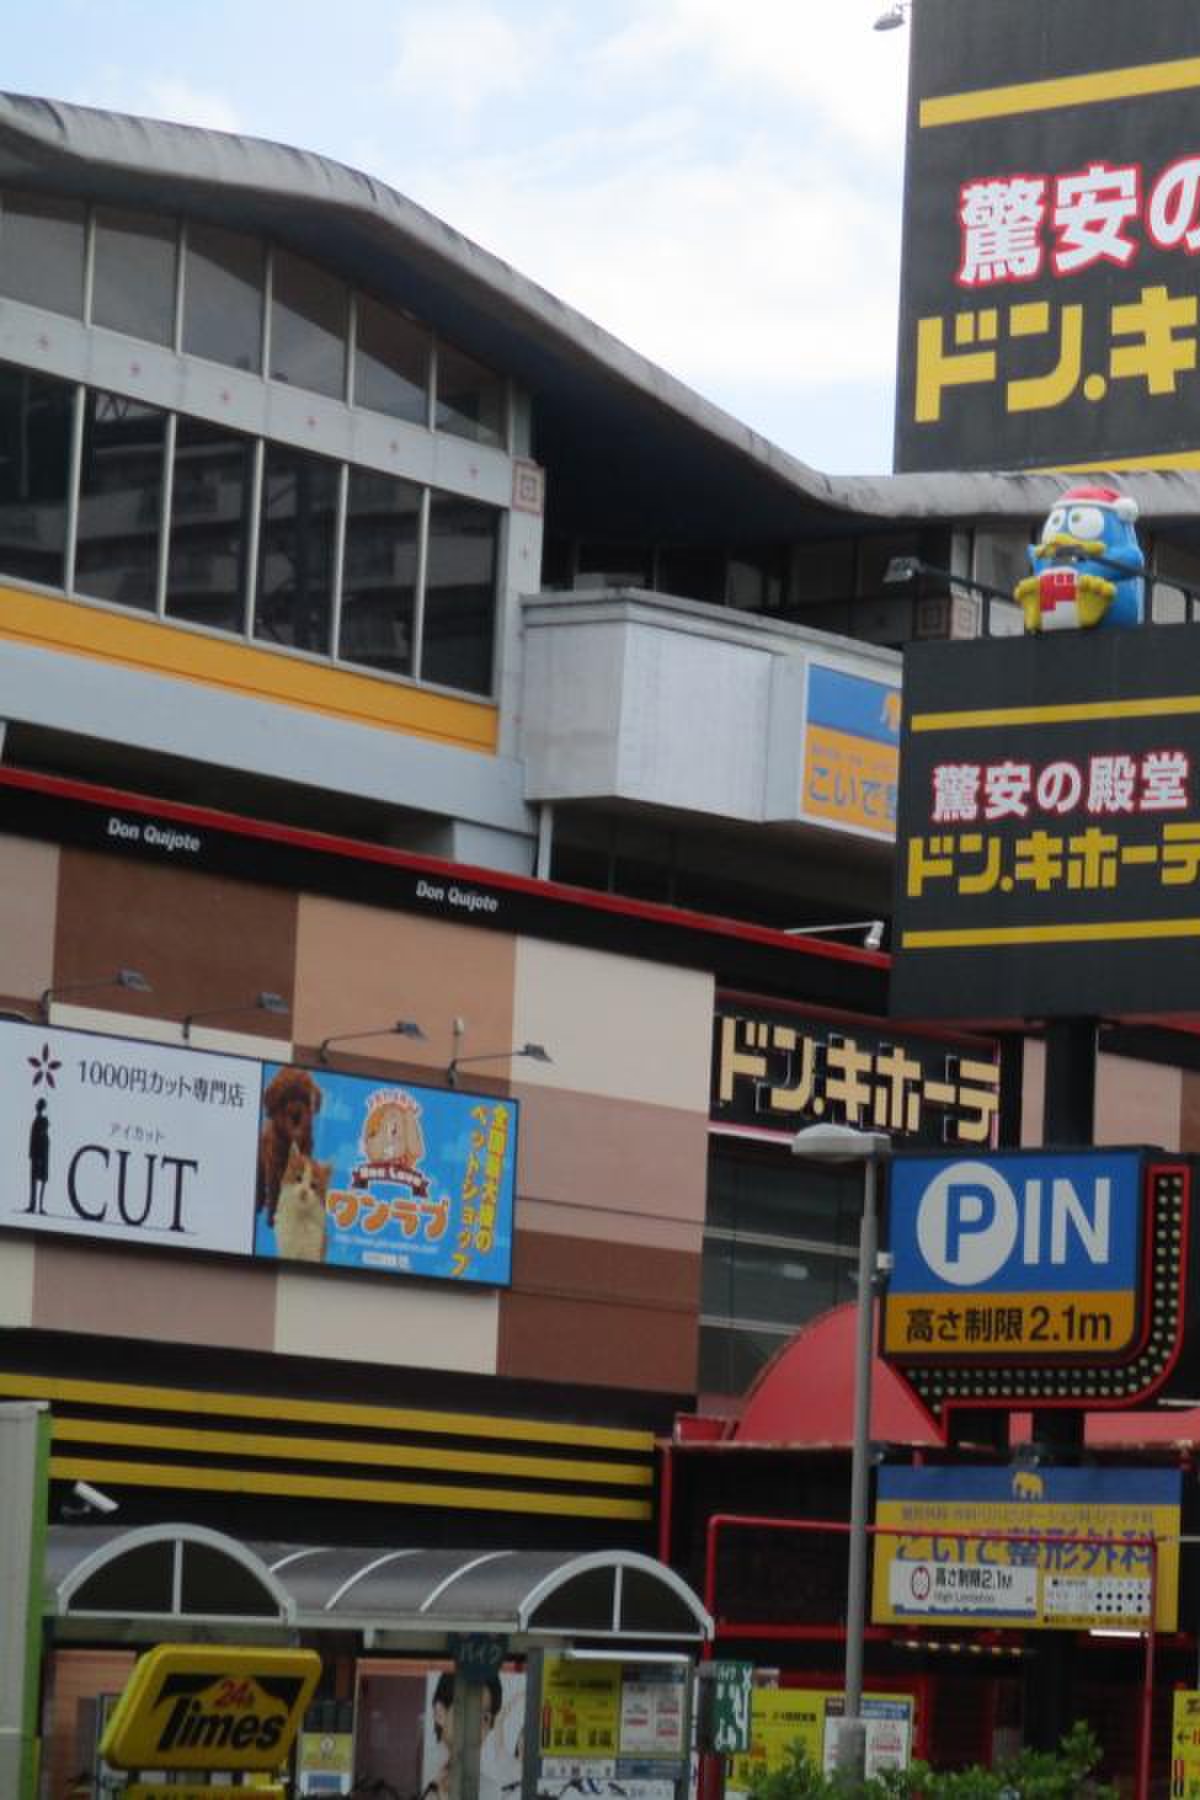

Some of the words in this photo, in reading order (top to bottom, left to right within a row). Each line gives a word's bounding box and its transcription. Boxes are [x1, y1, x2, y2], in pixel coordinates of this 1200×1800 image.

[931, 751, 1191, 823] 驚安の殿堂
[107, 818, 140, 838] Don
[143, 824, 201, 853] Quijote
[416, 880, 445, 900] Don
[447, 887, 498, 913] Quijote
[67, 1143, 199, 1233] CUT
[1022, 1177, 1112, 1265] IN
[906, 1306, 1112, 1344] 高さ制限2.1m
[152, 1677, 292, 1752] Times
